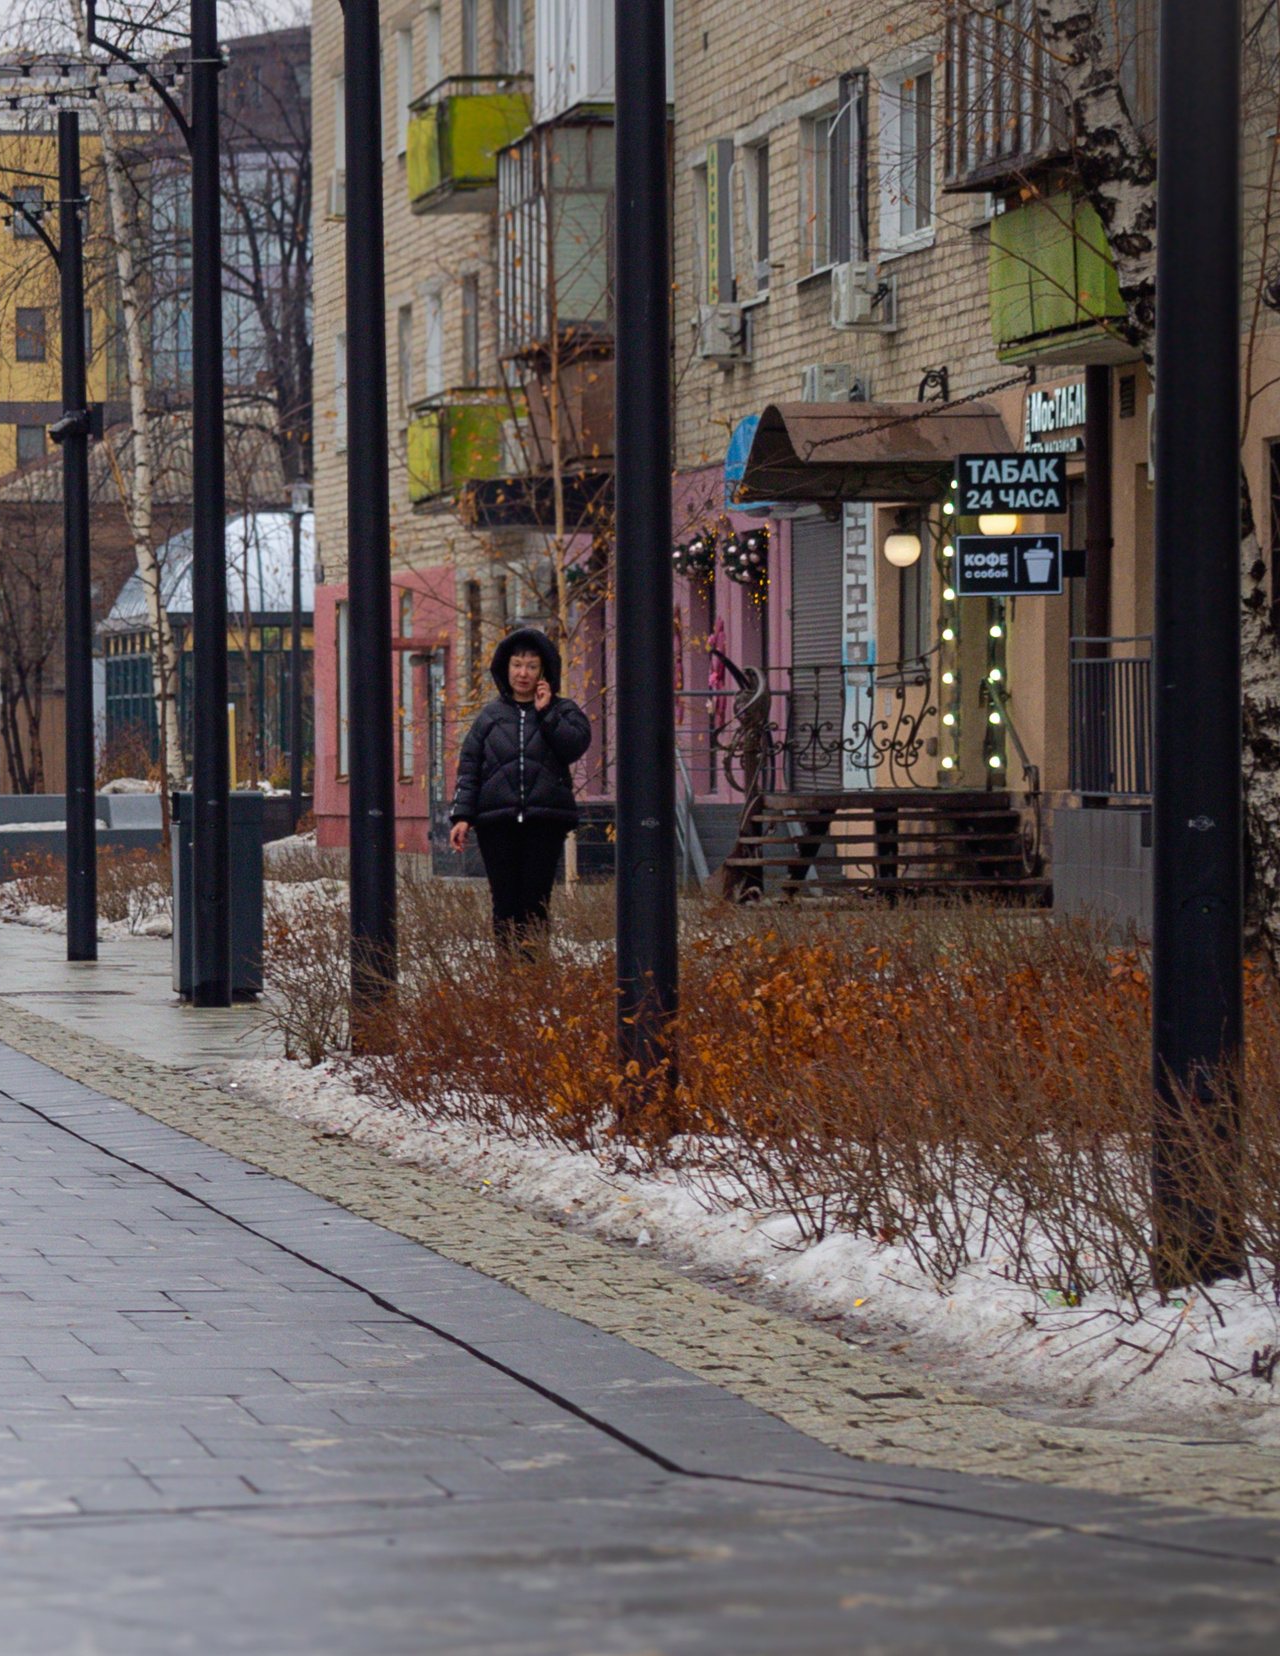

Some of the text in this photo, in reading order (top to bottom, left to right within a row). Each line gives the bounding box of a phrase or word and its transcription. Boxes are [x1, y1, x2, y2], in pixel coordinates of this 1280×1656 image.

[966, 458, 1059, 484] ТАБАК
[966, 488, 1060, 509] 24 ЧАСА
[964, 552, 1009, 567] КОФЕ
[965, 567, 1009, 579] с собой
